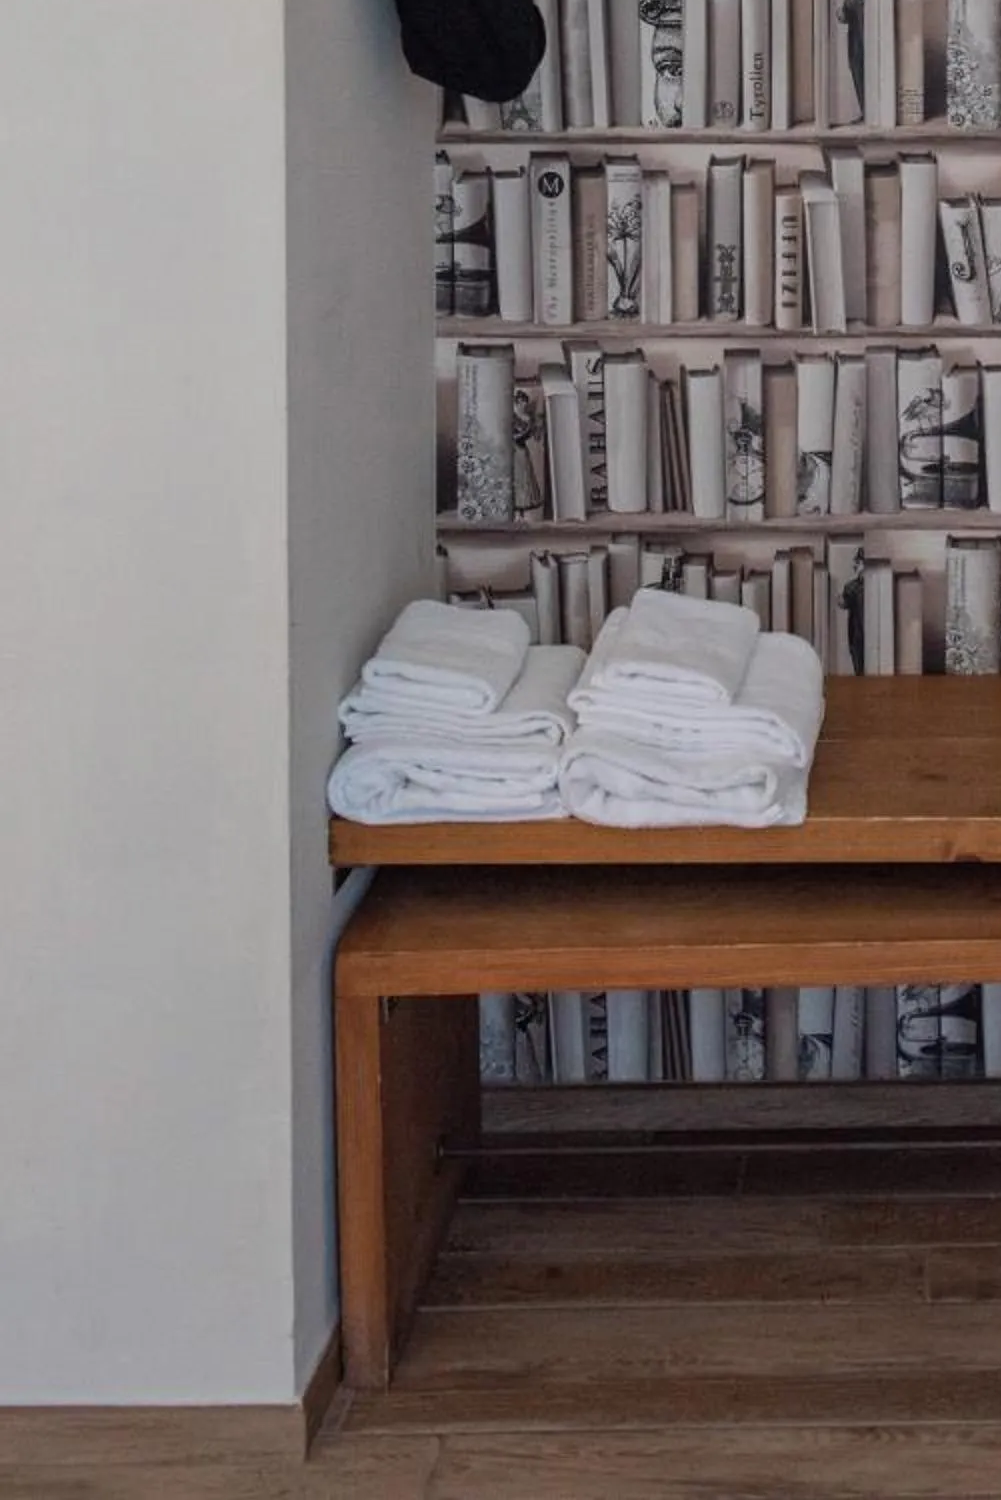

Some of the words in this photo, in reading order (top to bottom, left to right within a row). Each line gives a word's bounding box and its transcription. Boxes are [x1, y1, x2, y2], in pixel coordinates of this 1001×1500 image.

[749, 51, 765, 121] Tyrolien
[539, 172, 563, 196] M
[782, 214, 799, 309] UFFIZI
